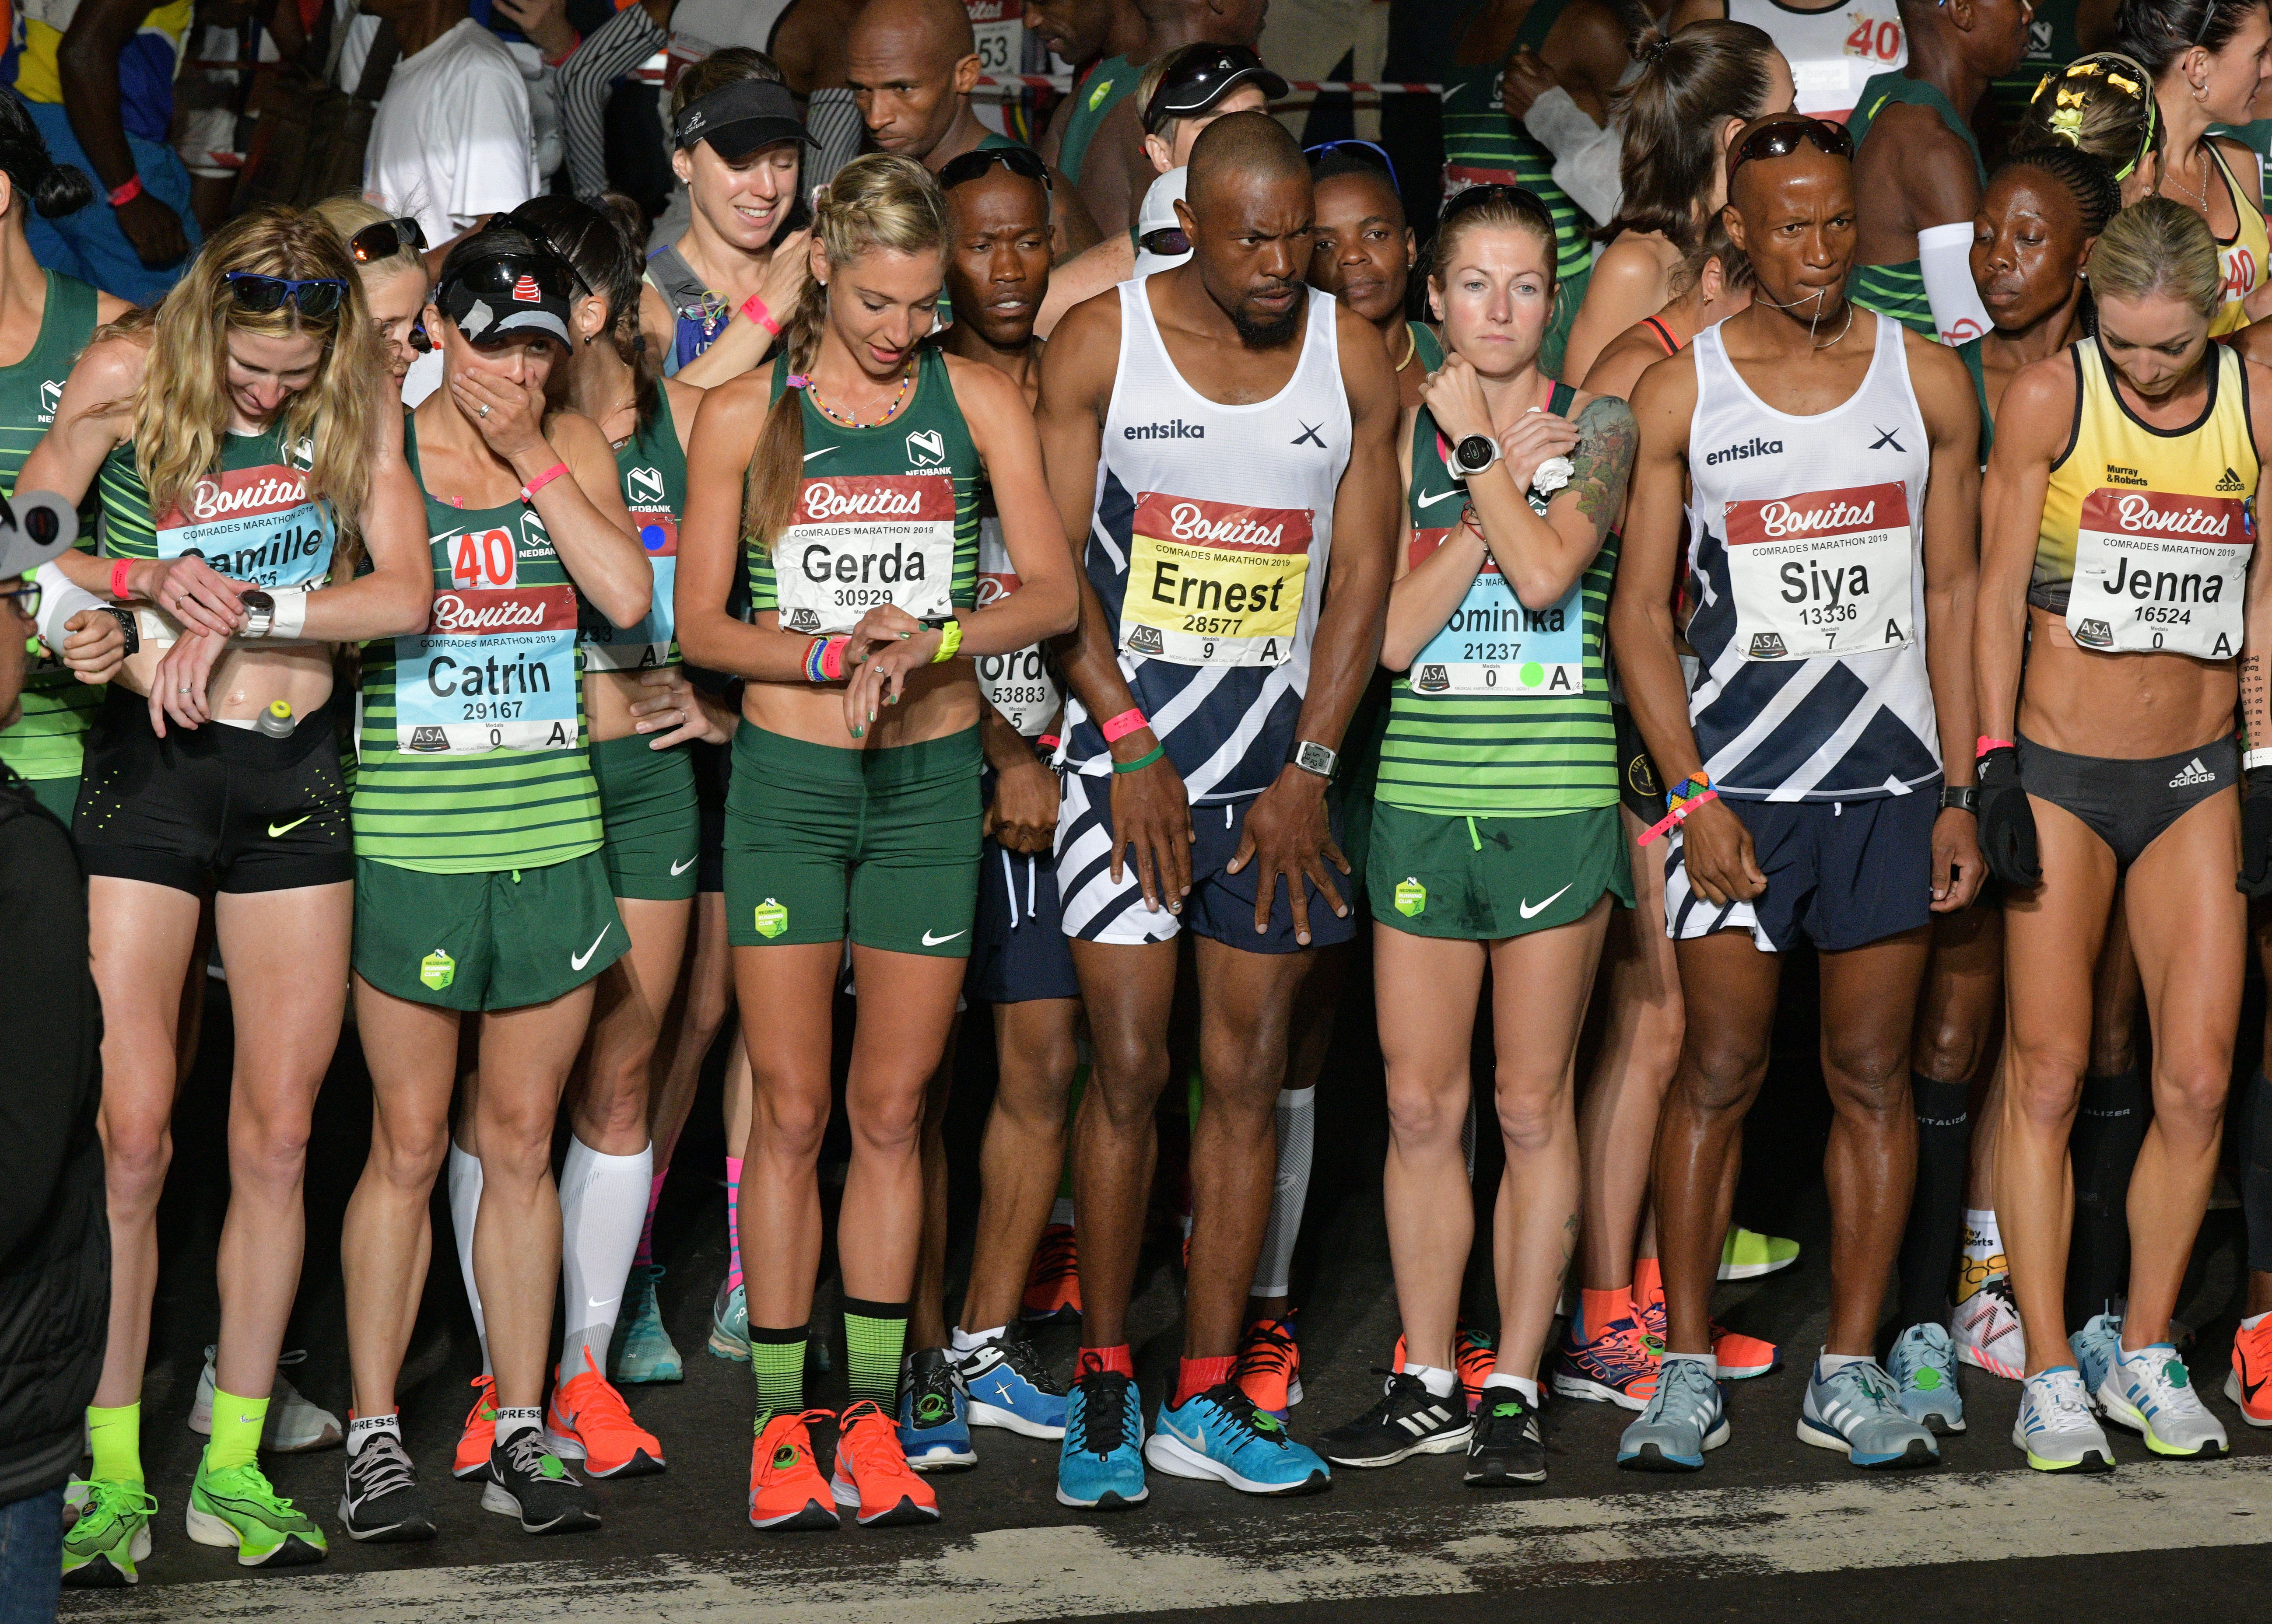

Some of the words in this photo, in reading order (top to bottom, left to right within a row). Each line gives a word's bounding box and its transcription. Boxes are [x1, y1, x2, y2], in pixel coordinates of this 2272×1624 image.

[1847, 19, 1900, 60] 40
[2227, 250, 2255, 297] 40
[1124, 419, 1204, 440] entsika
[1706, 438, 1783, 466] entsika
[2107, 464, 2138, 476] Murray
[193, 476, 306, 518] Bonitas
[2216, 482, 2245, 492] adidas
[804, 483, 922, 519] Bonitas
[183, 524, 240, 540] COMRADES
[243, 512, 295, 530] MARATHON
[297, 505, 314, 517] 2019
[1171, 503, 1283, 547] Bonitas
[1760, 500, 1875, 536] Bonitas
[2118, 494, 2230, 537] Bonitas
[794, 528, 851, 537] COMRADES
[854, 526, 910, 535] MARATHON
[913, 526, 934, 534] 2019
[519, 547, 557, 558] NEDBAN
[1156, 544, 1211, 560] COMRADES
[1213, 553, 1269, 566] MARATHON
[1752, 544, 1809, 556] COMRADES
[1812, 537, 1865, 551] MARATHON
[1868, 534, 1888, 544] 2019
[2103, 538, 2160, 551] COMRADES
[2162, 544, 2216, 556] MARATHON
[454, 529, 514, 587] 40
[802, 542, 925, 584] Gerda
[1151, 560, 1284, 612] Ernest
[1485, 578, 1510, 587] MARA
[1780, 560, 1870, 611] Siya
[2103, 557, 2223, 603] Jenna
[834, 589, 893, 606] 30929
[433, 595, 547, 629] Bonitas
[792, 611, 818, 624] ASA
[1448, 601, 1565, 632] ominika
[1799, 603, 1857, 625] 13336
[2134, 606, 2191, 625] 16524
[579, 626, 613, 642] 233
[1182, 614, 1243, 635] 28577
[1885, 618, 1904, 644] A
[2080, 620, 2111, 638] ASA
[421, 639, 477, 648] COMRADES
[480, 636, 533, 647] MARATHON
[536, 635, 557, 644] 2019
[1132, 627, 1161, 645] ASA
[1753, 635, 1782, 648] ASA
[1825, 633, 1837, 650] 7
[2153, 632, 2163, 648] 0
[2211, 632, 2233, 656] A
[640, 645, 658, 668] A
[1203, 642, 1214, 658] 9
[1259, 638, 1280, 662] A
[1463, 643, 1522, 660] 21237
[980, 641, 1044, 681] ord
[428, 653, 550, 697] Catrin
[1422, 667, 1446, 681] ASA
[1486, 670, 1497, 687] 0
[1549, 665, 1571, 690] A
[992, 686, 1045, 704] 53883
[463, 701, 523, 720] 29167
[1012, 713, 1023, 729] 5
[414, 729, 445, 742] ASA
[490, 728, 501, 746] 0
[545, 721, 566, 746] A
[2168, 772, 2216, 788] adidas
